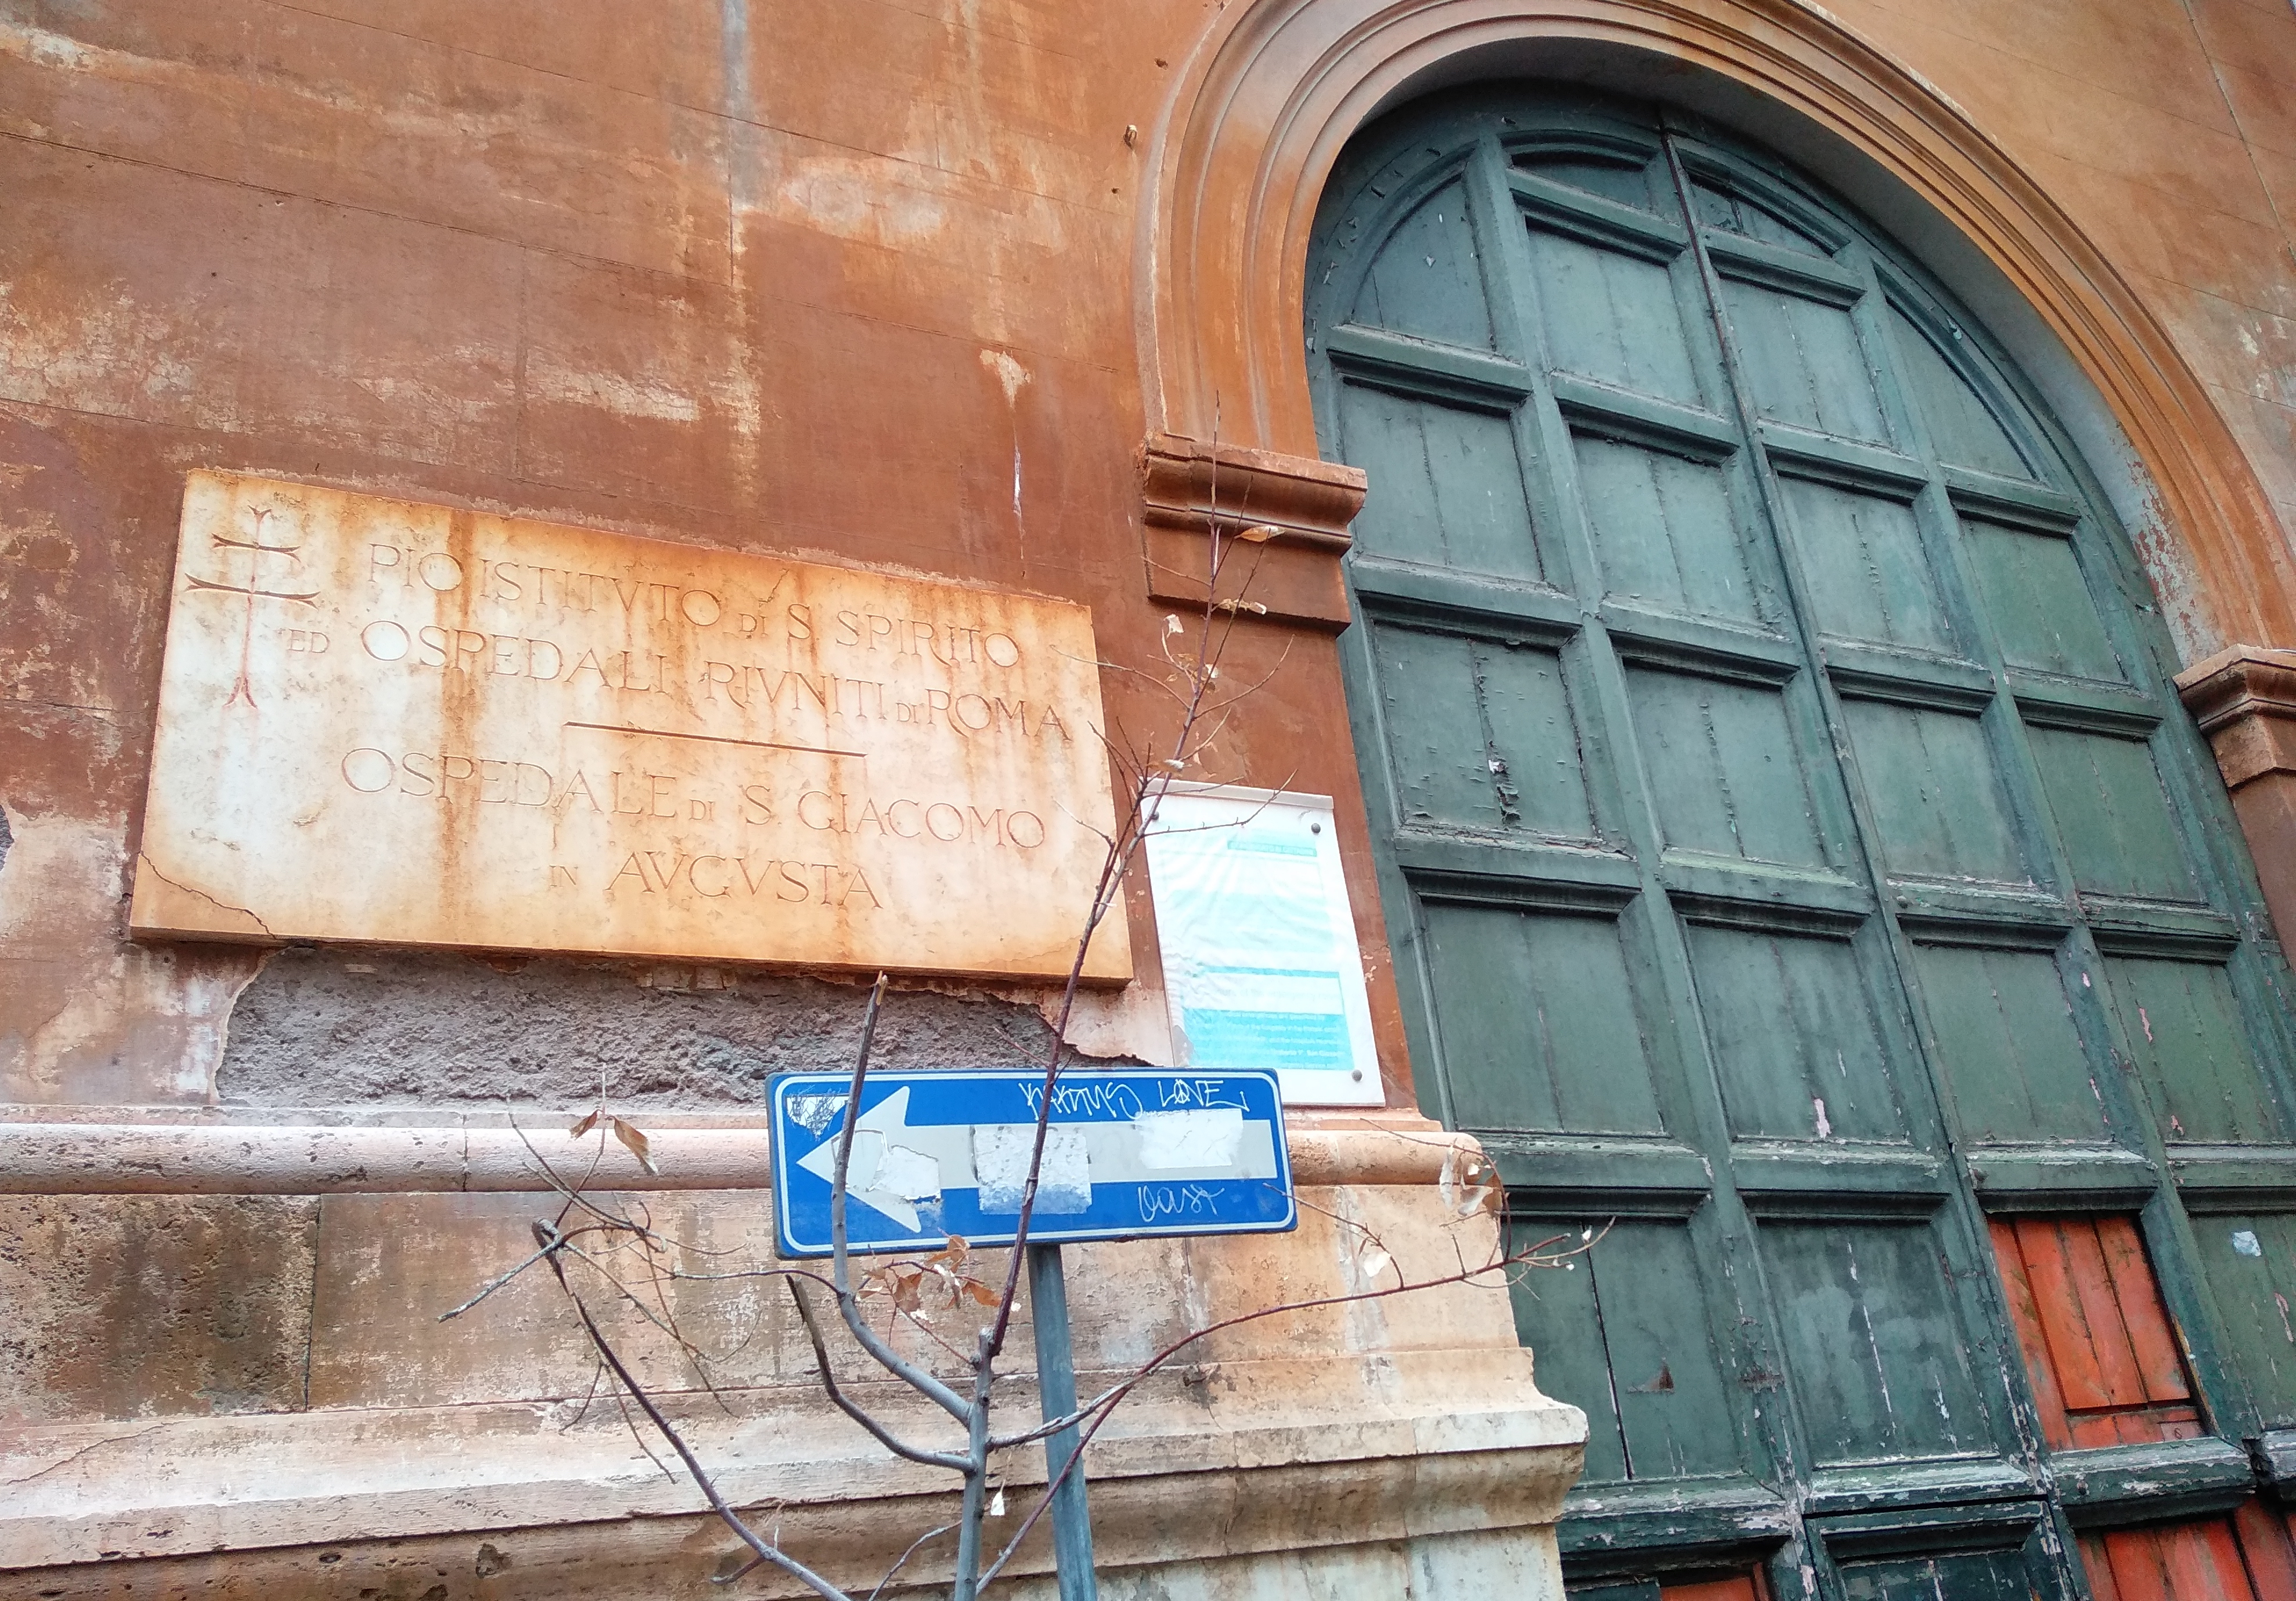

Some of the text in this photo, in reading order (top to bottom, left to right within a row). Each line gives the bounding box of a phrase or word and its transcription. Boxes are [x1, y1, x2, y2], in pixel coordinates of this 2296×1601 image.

[368, 543, 1019, 668] PIO ISTITVTO DI S SPIRITO
[284, 620, 1072, 742] ED OSPEDALI RIVNITI DI ROMA
[341, 748, 1045, 849] OSPEDALE DI S GIACOMO
[549, 850, 883, 910] IN AVGVSTA
